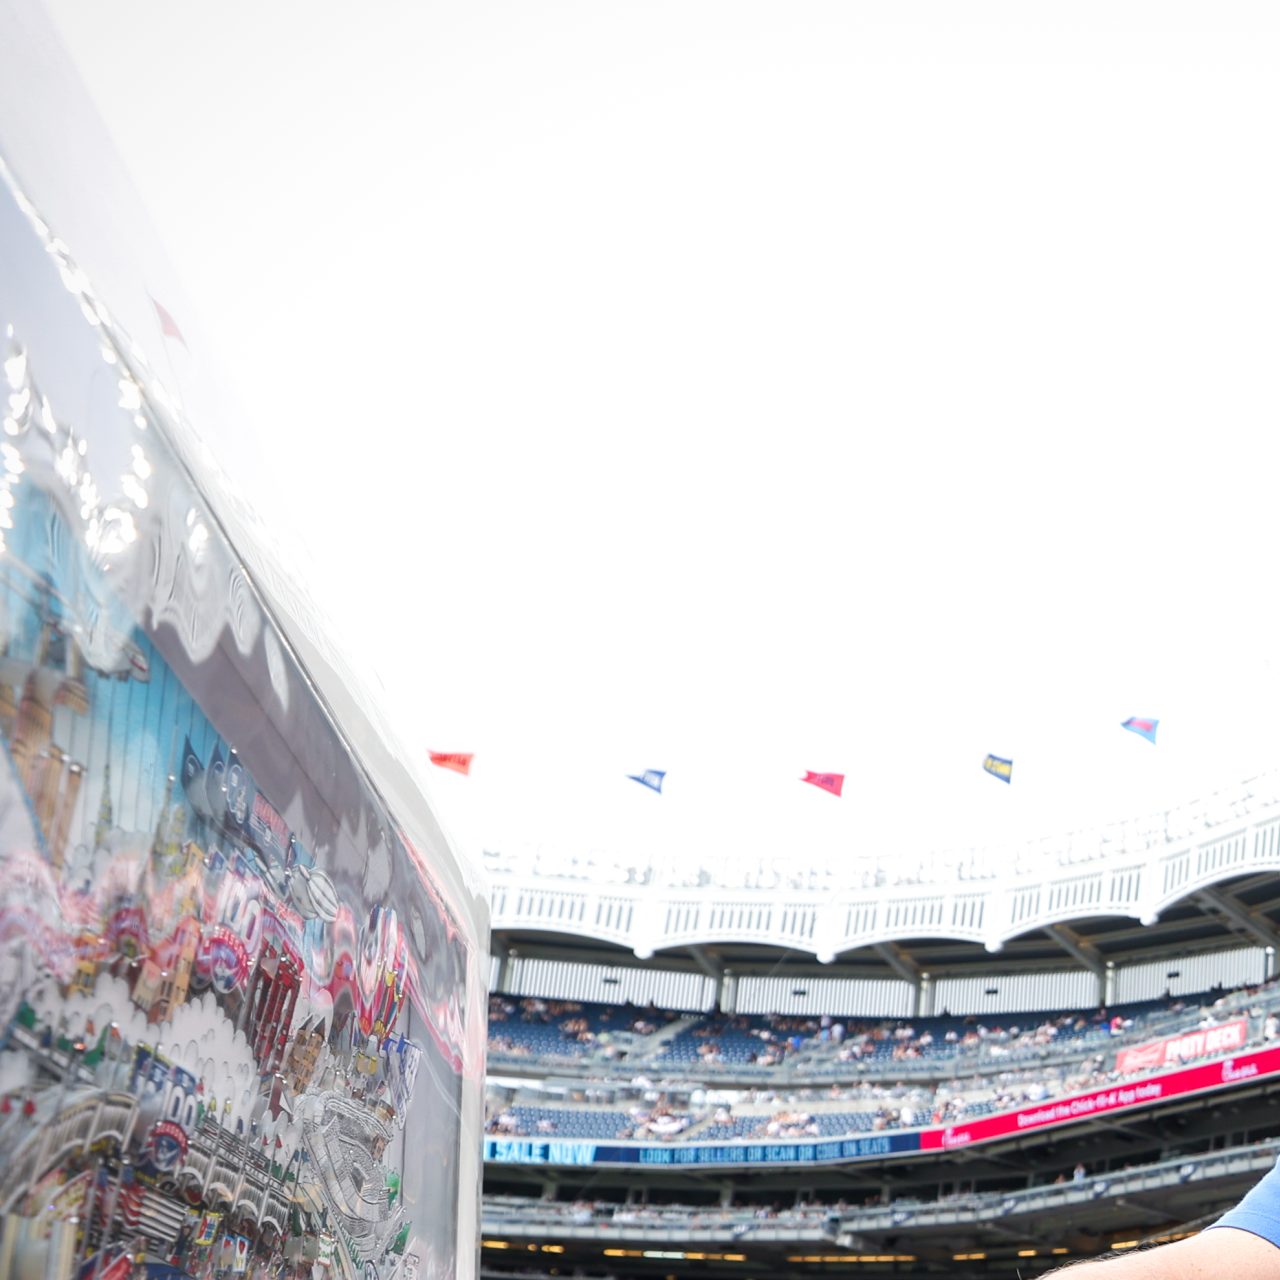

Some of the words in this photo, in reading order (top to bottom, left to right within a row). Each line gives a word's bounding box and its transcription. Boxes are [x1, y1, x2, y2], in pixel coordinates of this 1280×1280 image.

[1165, 1032, 1205, 1061] PARTY
[1205, 1023, 1241, 1051] DECK
[495, 1143, 545, 1162] SALE
[550, 1144, 597, 1165] NOW
